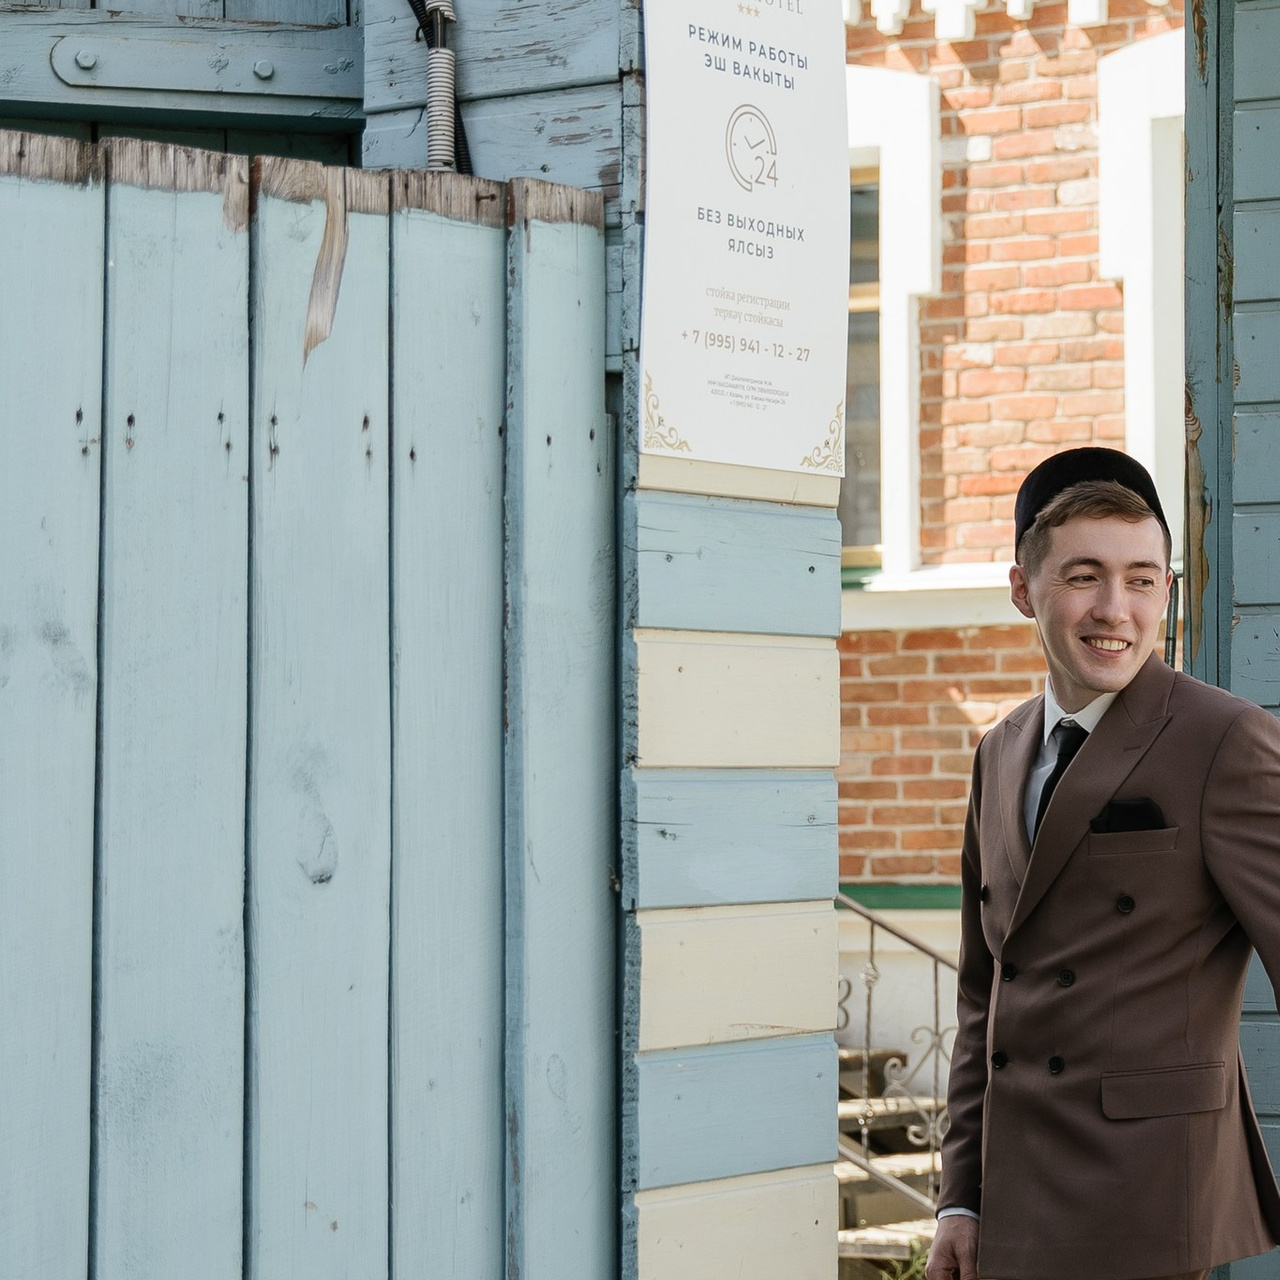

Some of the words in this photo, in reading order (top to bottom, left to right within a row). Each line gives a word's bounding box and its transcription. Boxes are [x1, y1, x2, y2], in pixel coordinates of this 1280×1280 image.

[688, 23, 743, 53] РЕЖИМ
[749, 41, 808, 71] РАБОТЫ
[704, 53, 726, 72] ЭШ
[733, 61, 795, 91] ВАКЫТЫ
[754, 156, 779, 188] 24
[697, 207, 722, 224] БЕЗ
[727, 213, 805, 242] ВЫХОДНЫХ
[728, 238, 775, 260] ЯЛСЫЗ
[705, 287, 736, 301] стойка
[737, 293, 791, 311] регистрации
[744, 312, 784, 328] стойкасы
[704, 331, 736, 354] (995)
[740, 338, 760, 355] 941
[796, 347, 811, 362] 27
